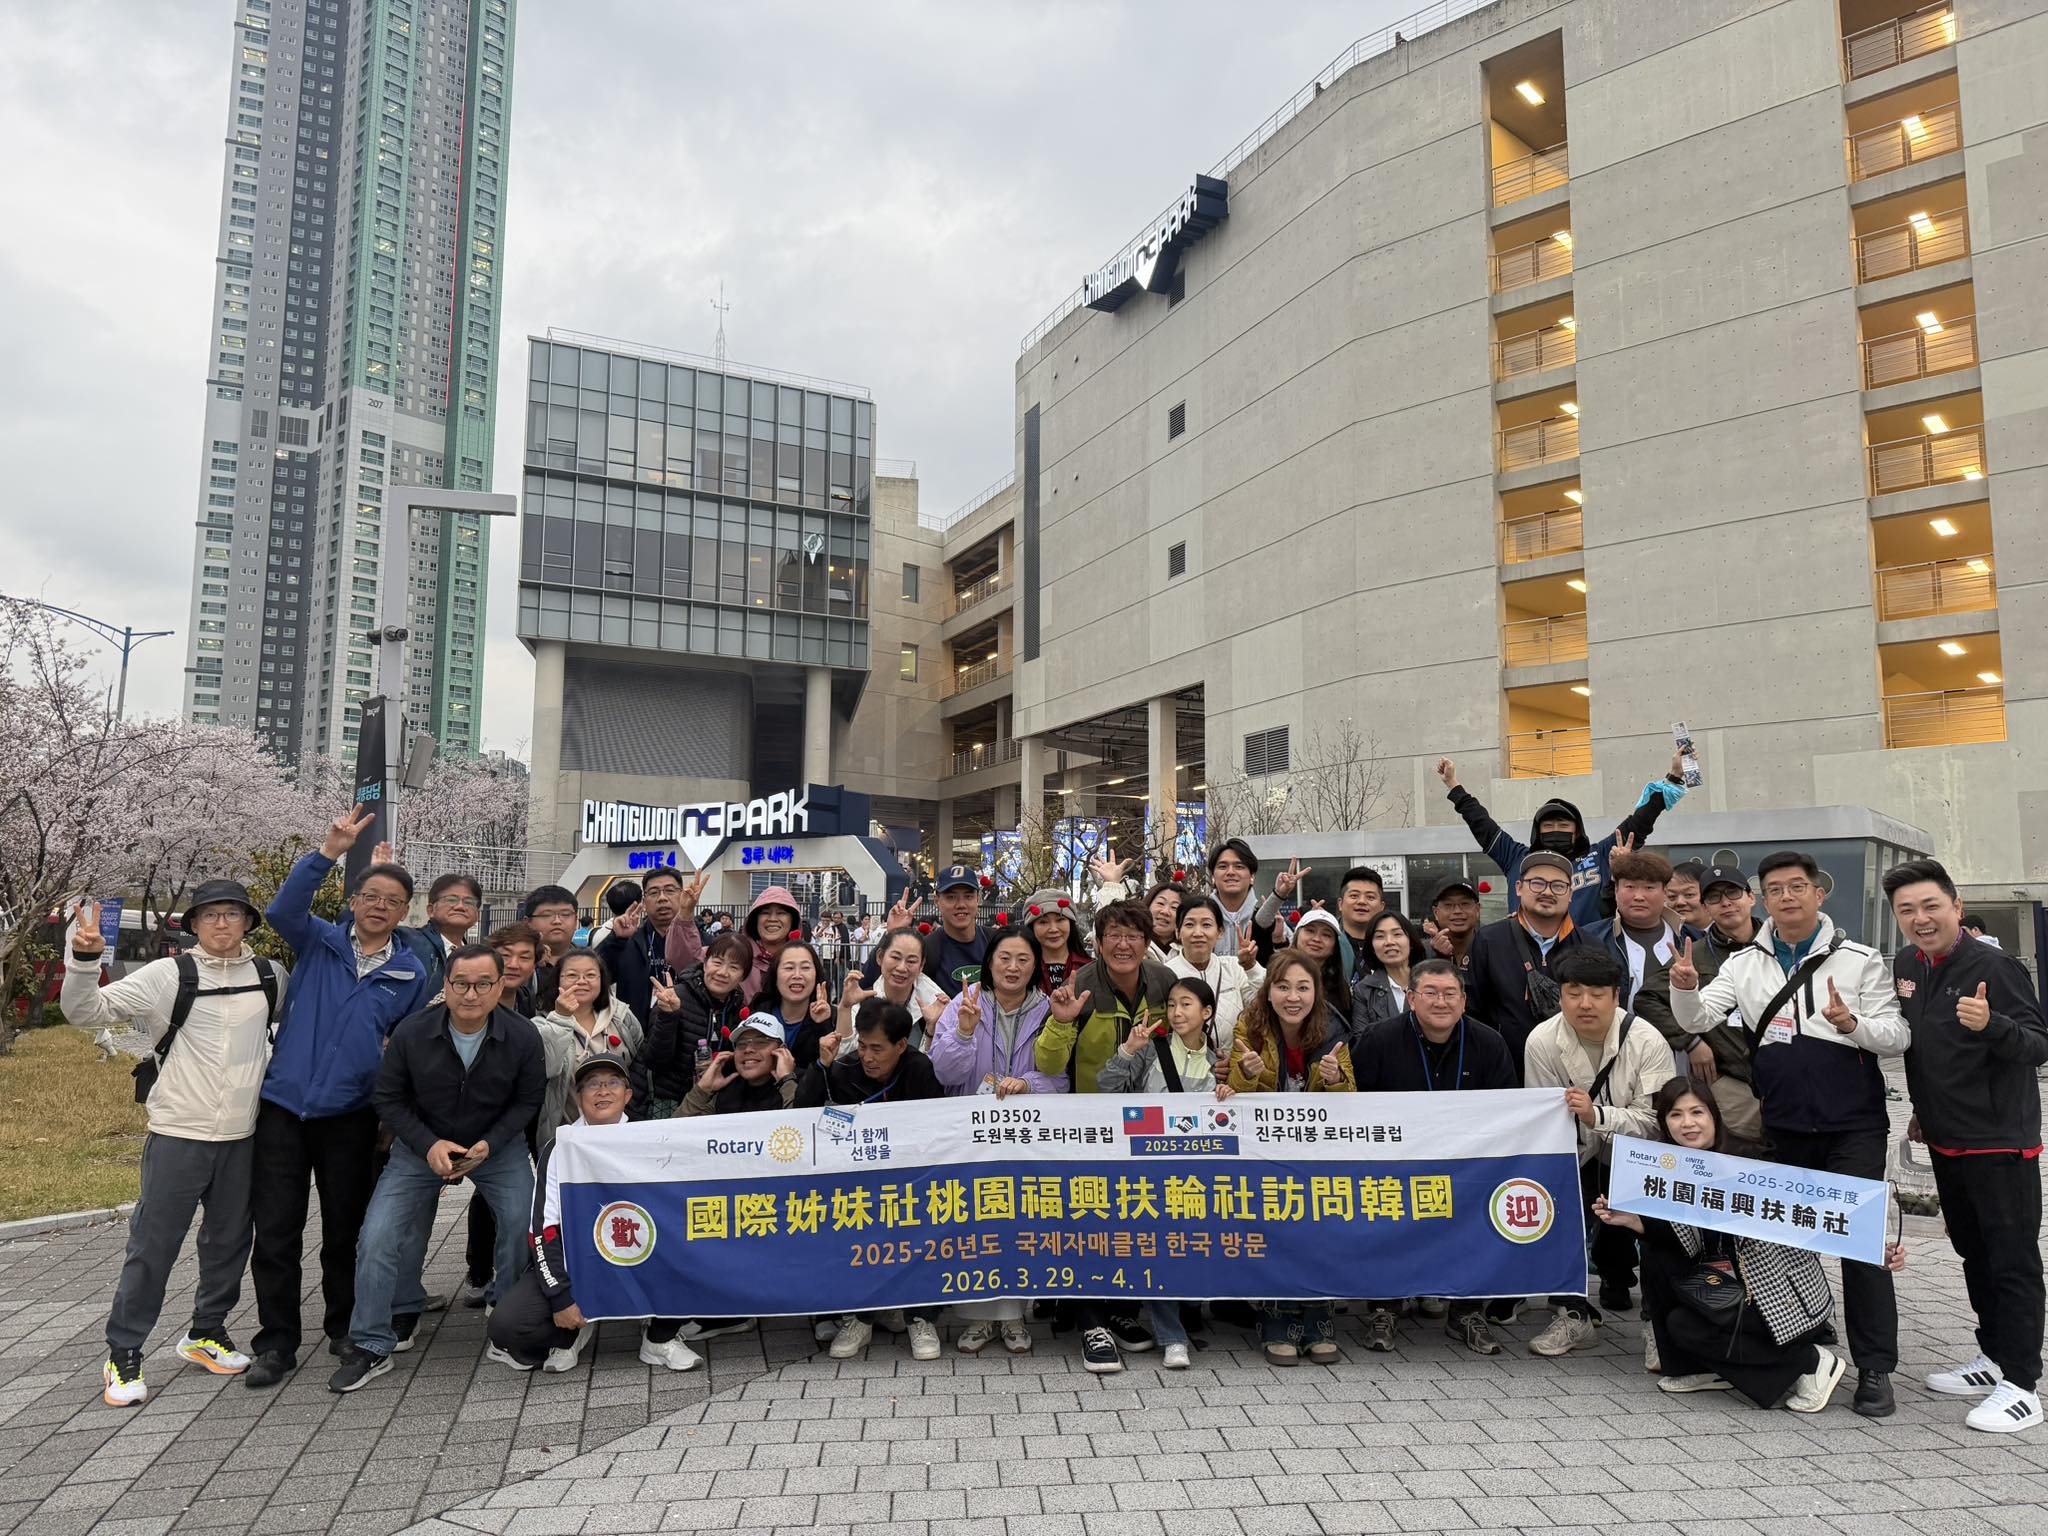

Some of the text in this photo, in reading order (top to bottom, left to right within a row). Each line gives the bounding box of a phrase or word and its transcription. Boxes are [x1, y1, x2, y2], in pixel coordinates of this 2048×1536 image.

[1082, 251, 1134, 308] CHANGWON
[1158, 186, 1198, 252] PARK
[367, 397, 384, 409] 207
[581, 784, 809, 844] CHANGWON NC PARK
[628, 850, 676, 870] GATE 4
[972, 1109, 1042, 1125] RI D3502
[1254, 1108, 1328, 1122] RI D3590
[861, 1127, 889, 1144] 함께
[972, 1126, 1115, 1144] 도원복흥 로타리클럽
[1255, 1126, 1402, 1143] 진주대봉 로타리클럽
[707, 1137, 764, 1156] Rotary
[850, 1144, 892, 1162] 선행을
[1144, 1138, 1225, 1152] 2025-26년도
[1630, 1150, 1658, 1164] Rotary
[1685, 1156, 1705, 1165] UNITE
[1691, 1163, 1706, 1171] FOR
[1693, 1169, 1713, 1178] GOOD
[1737, 1171, 1860, 1206] 2025-2026年度
[1506, 1194, 1541, 1230] 迎
[1643, 1174, 1850, 1237] 桃園福興扶輪社
[611, 1217, 642, 1250] 歡
[850, 1231, 1268, 1267] 2025-26년도 국제자매클럽 한국 방문
[534, 1235, 559, 1288] le coq sportif
[941, 1268, 1010, 1294] 2026.
[1016, 1268, 1038, 1290] 3.
[1046, 1267, 1083, 1290] 29.
[1112, 1267, 1134, 1290] 4.
[1144, 1268, 1164, 1290] 1.
